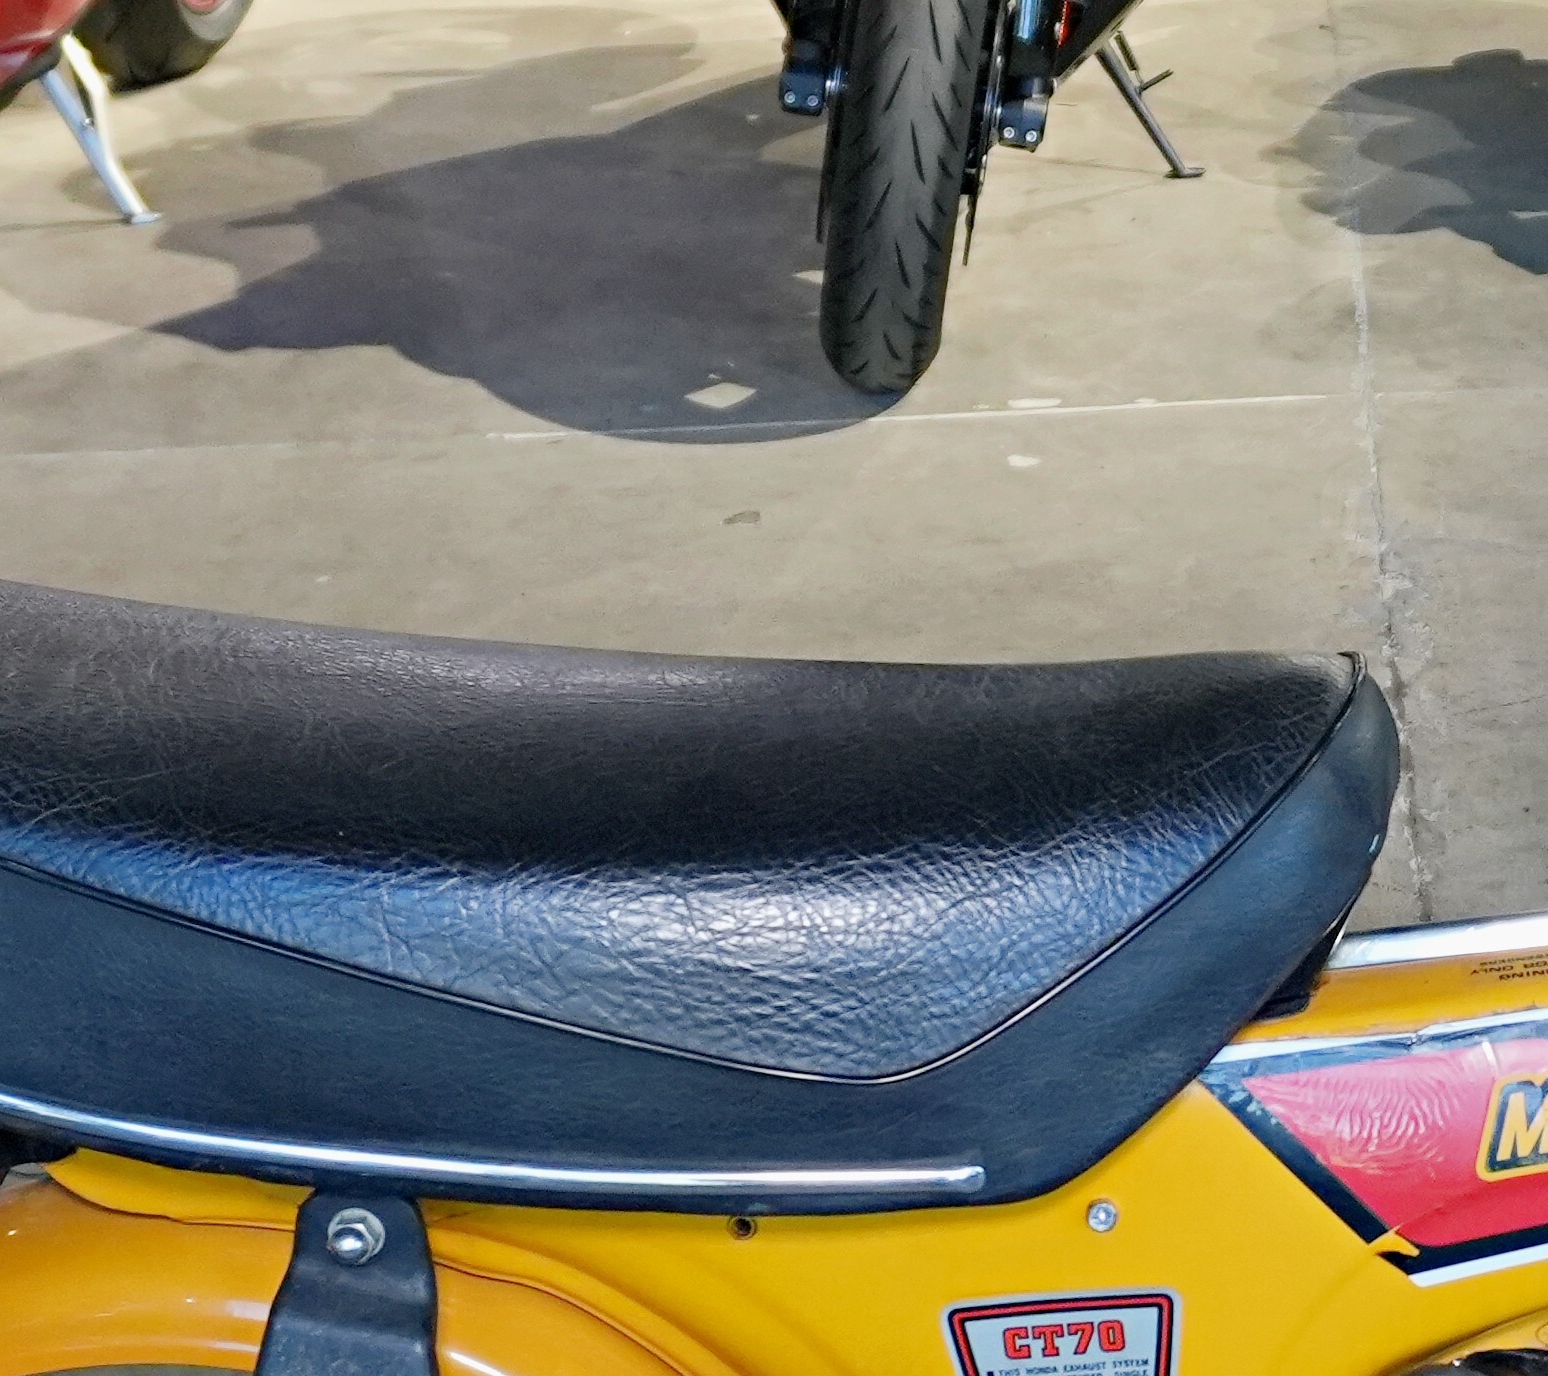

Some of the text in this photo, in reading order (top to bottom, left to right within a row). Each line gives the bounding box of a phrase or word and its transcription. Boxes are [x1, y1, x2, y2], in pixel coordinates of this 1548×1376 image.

[1470, 965, 1514, 976] ONLY
[1003, 1320, 1126, 1360] CT70
[1063, 1362, 1106, 1373] EXHAUST
[1113, 1359, 1149, 1369] SYSTEM
